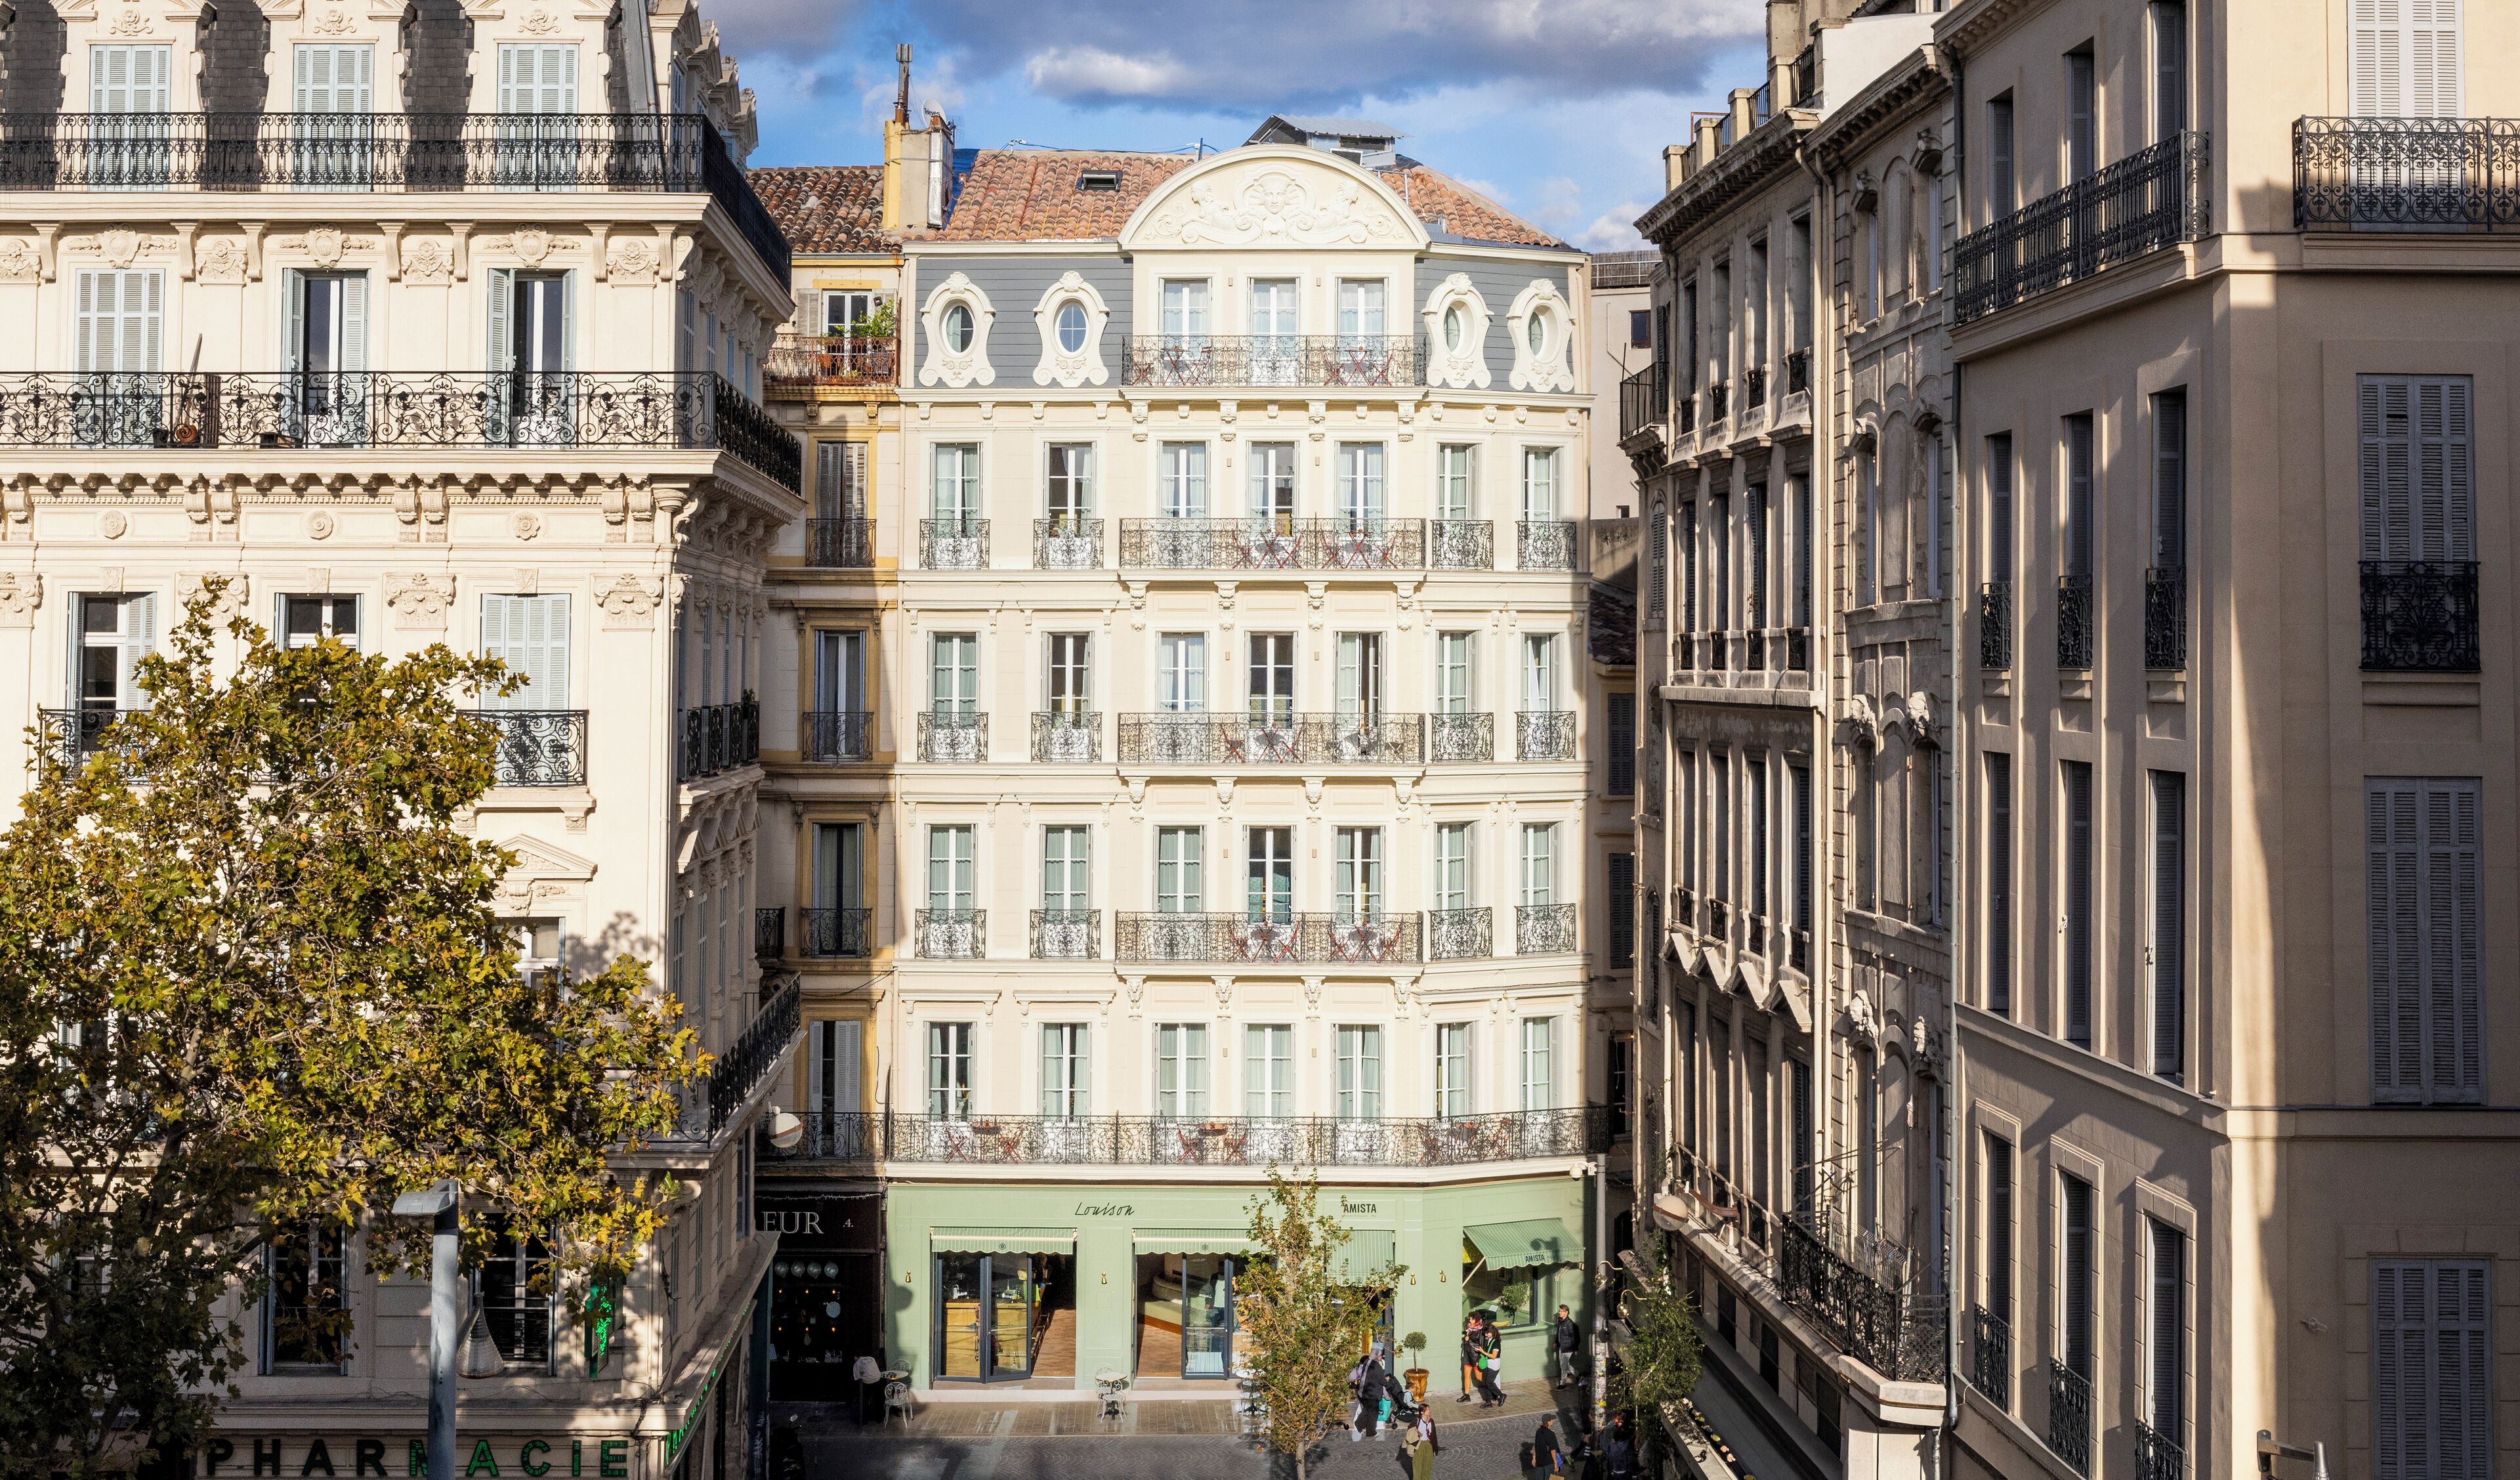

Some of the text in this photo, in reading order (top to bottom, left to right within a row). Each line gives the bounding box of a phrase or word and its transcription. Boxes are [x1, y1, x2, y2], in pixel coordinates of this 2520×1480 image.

[1074, 1202, 1135, 1216] Louison
[1343, 1203, 1377, 1214] AMISTA
[1525, 1254, 1545, 1263] AMISTA
